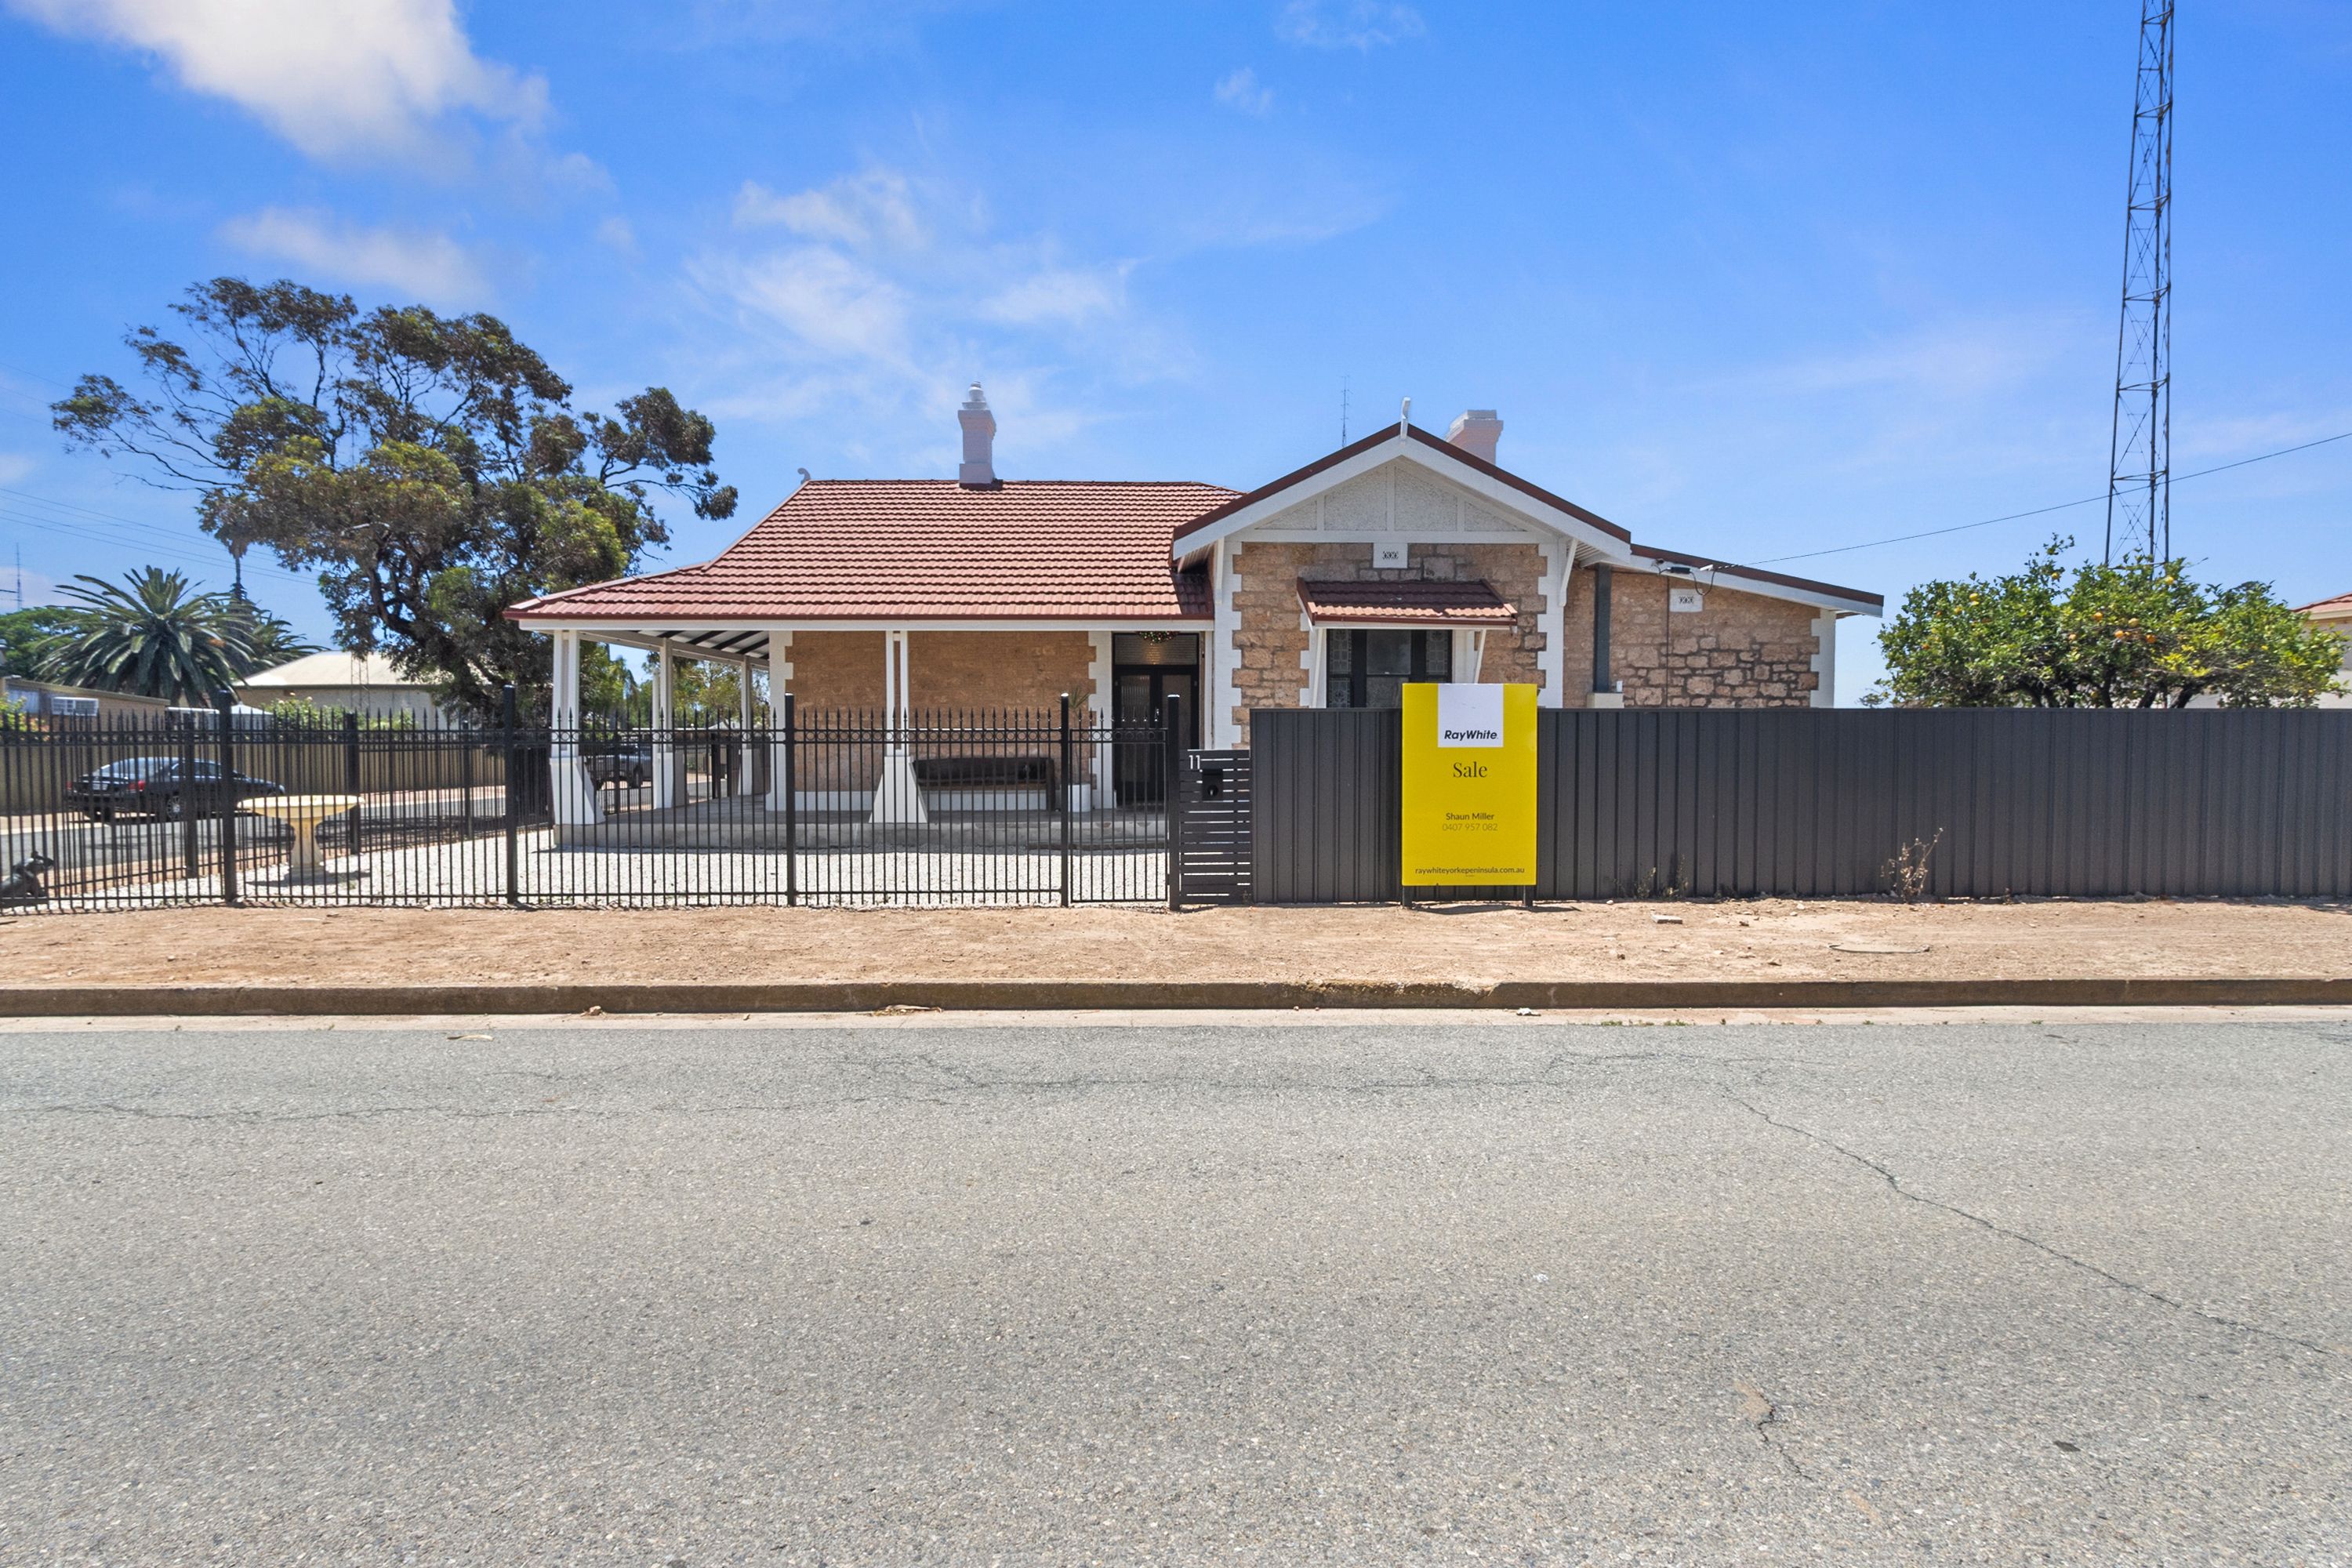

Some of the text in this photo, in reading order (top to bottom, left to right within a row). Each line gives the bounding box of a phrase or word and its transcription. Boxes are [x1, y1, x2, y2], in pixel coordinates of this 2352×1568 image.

[1444, 730, 1497, 741] RayWhite
[1189, 755, 1200, 770] 11
[1453, 761, 1488, 778] Sale
[1446, 812, 1495, 821] Shaun Miller
[1443, 822, 1498, 831] 0407 957 082
[1414, 866, 1525, 875] raywhiteyorkepeninsula.com.au
